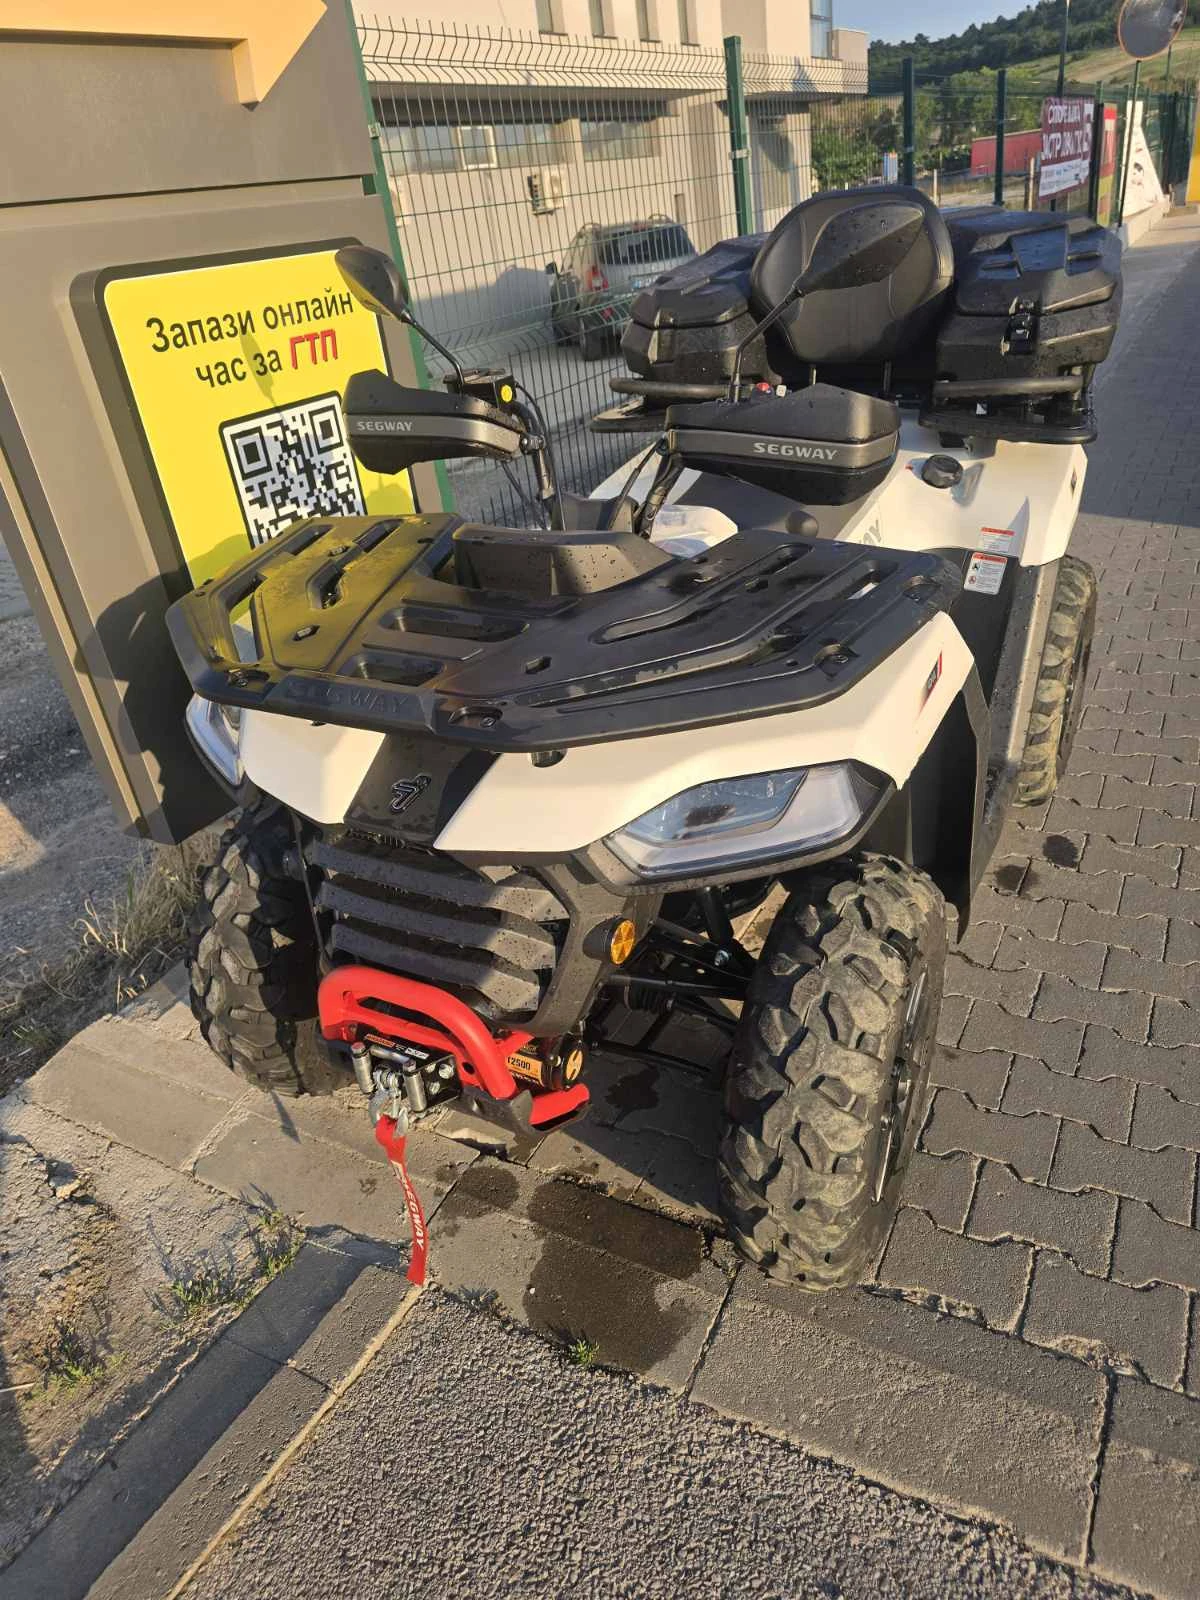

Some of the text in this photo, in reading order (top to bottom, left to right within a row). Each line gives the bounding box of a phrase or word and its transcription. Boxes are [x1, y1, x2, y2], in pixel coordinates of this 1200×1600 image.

[146, 286, 354, 353] Запази онлайн
[196, 328, 339, 388] час за ГТП
[356, 420, 413, 432] SEGWAY
[752, 441, 838, 461] SEGWAY
